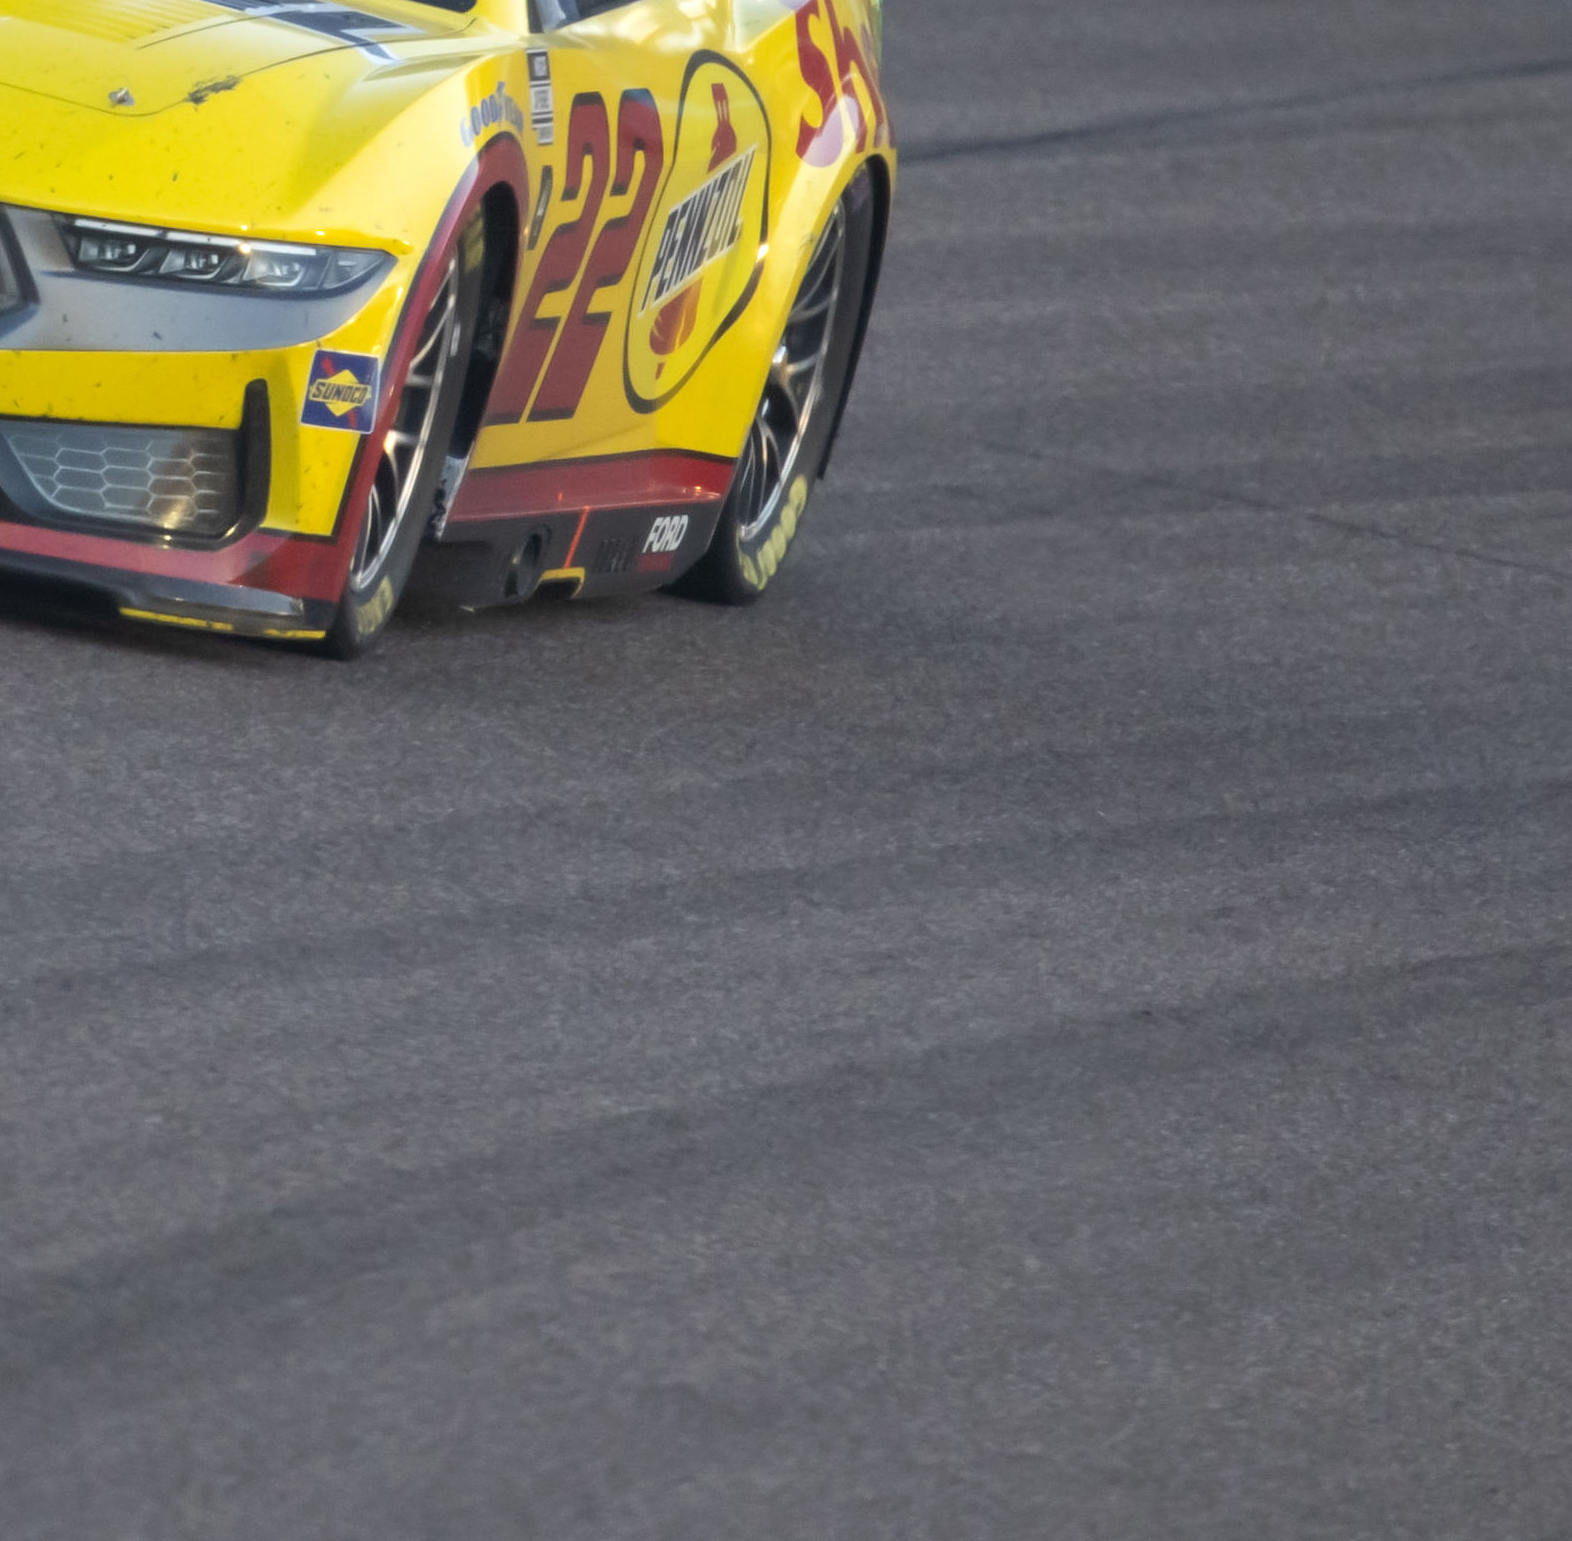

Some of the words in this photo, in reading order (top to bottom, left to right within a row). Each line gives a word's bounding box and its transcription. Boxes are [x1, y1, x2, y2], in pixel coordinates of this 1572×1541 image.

[481, 88, 664, 427] 22
[637, 143, 757, 318] PENNZOIL
[310, 379, 371, 405] SUNOCO
[642, 514, 689, 553] FORD
